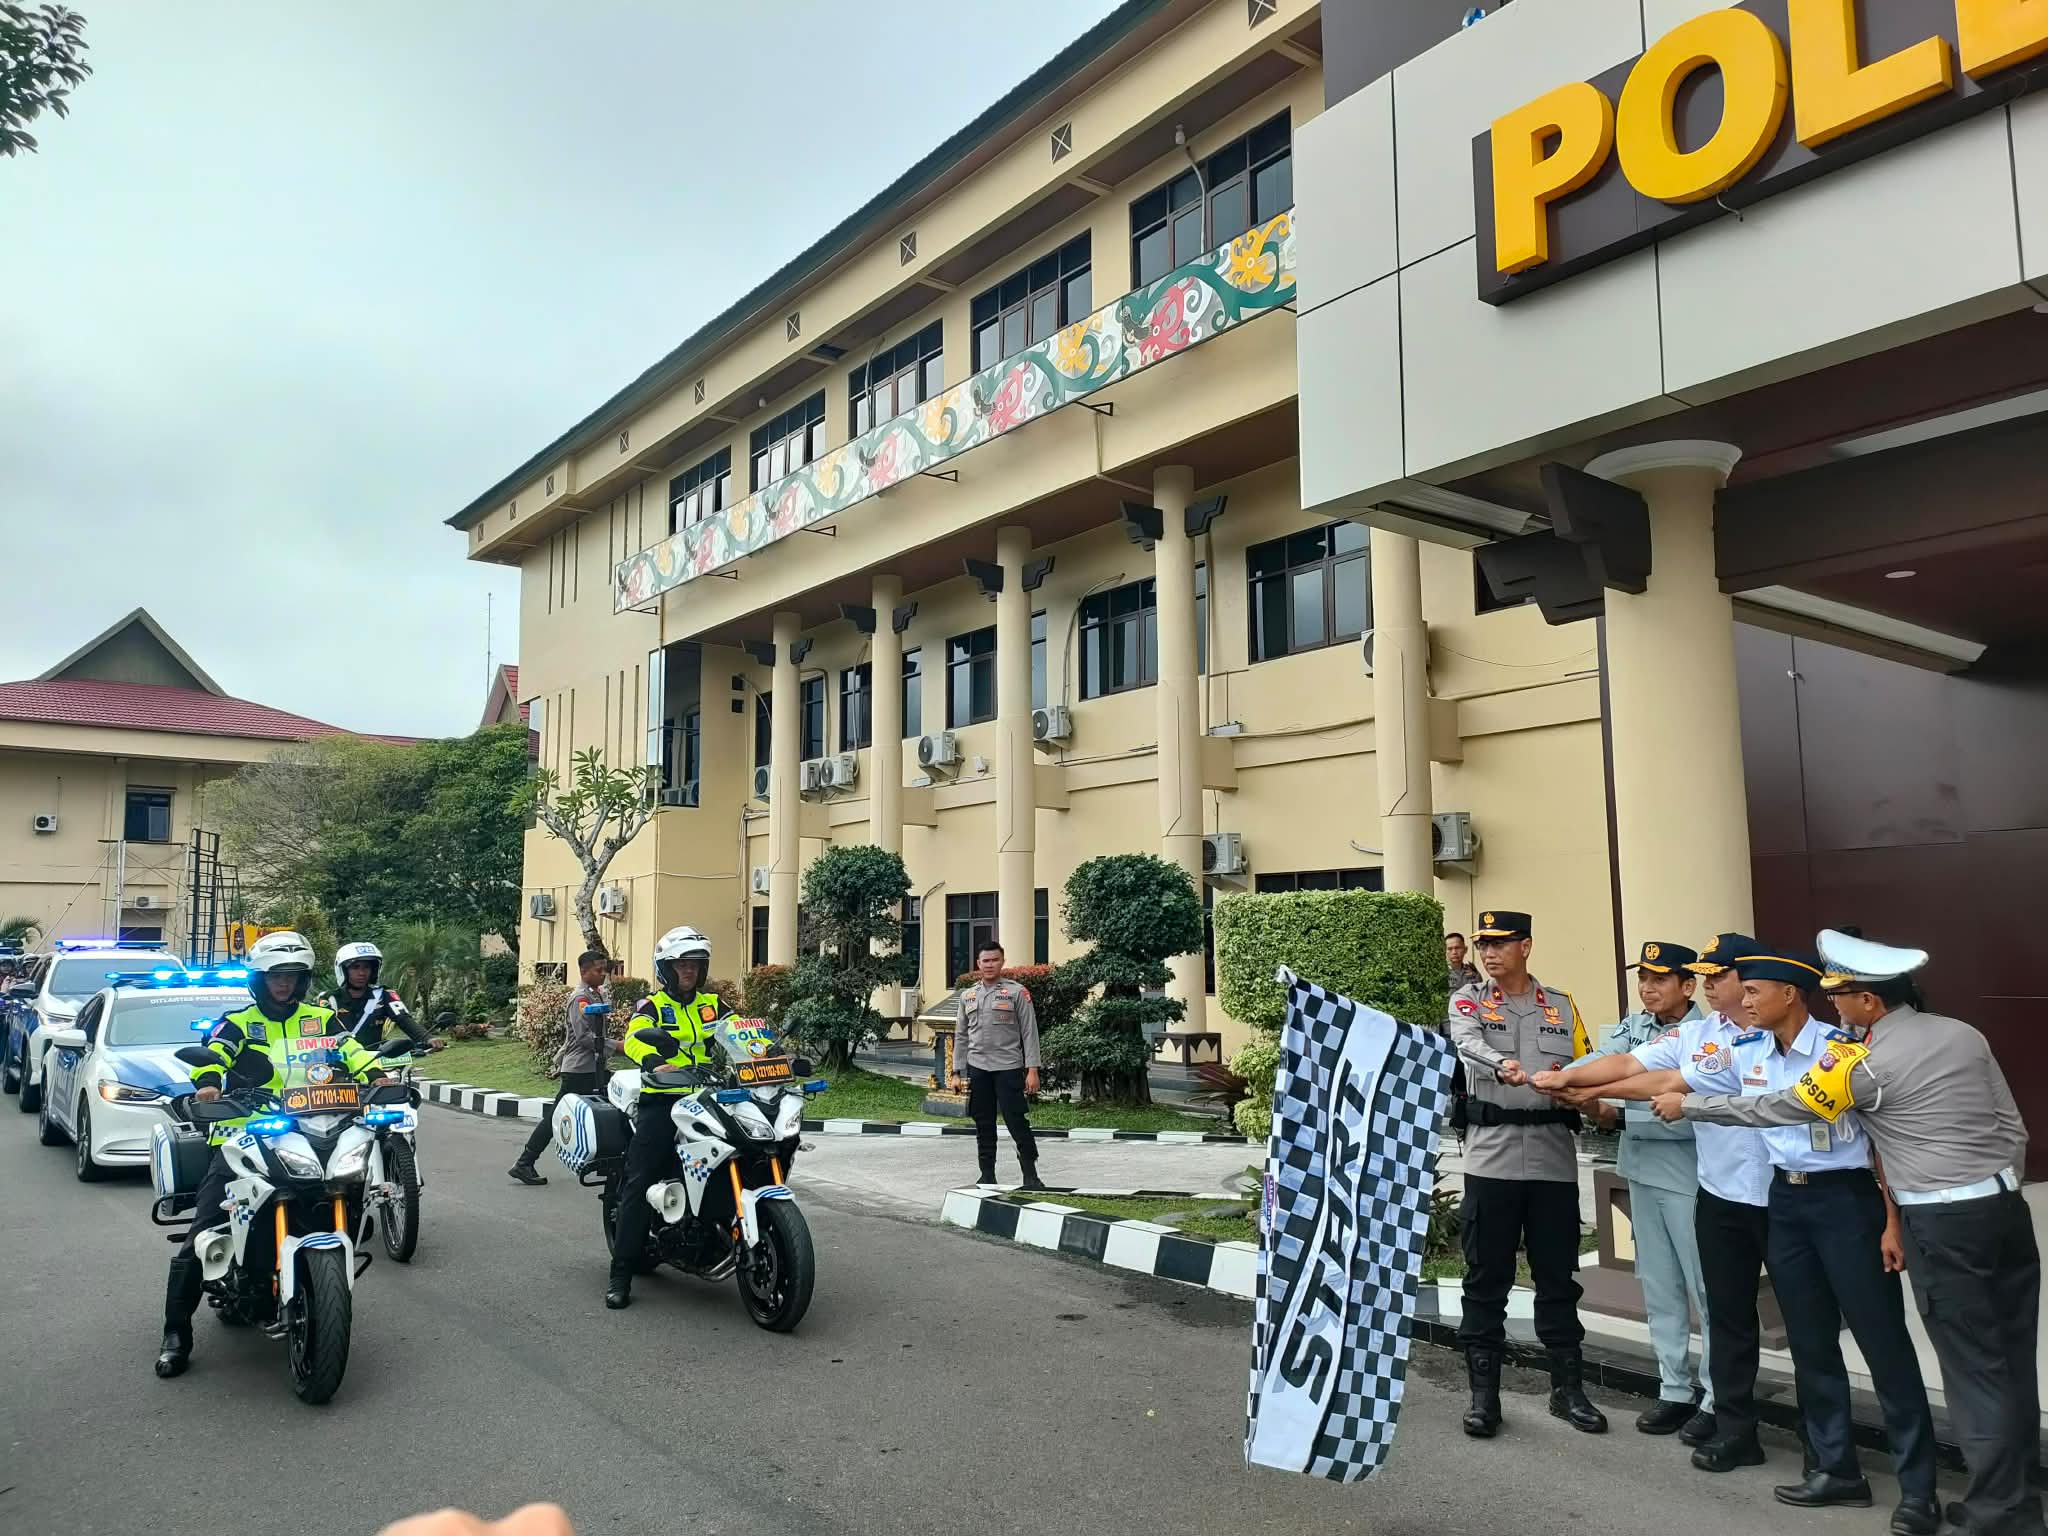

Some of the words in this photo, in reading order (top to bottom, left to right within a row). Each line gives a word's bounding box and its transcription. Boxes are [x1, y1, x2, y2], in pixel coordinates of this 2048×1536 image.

[1481, 1022, 1507, 1032] YOBI
[1539, 1026, 1569, 1037] POLRI
[296, 1039, 318, 1050] BM
[320, 1037, 337, 1049] 02
[1799, 1072, 1837, 1111] OPSDA
[1279, 1057, 1370, 1405] START
